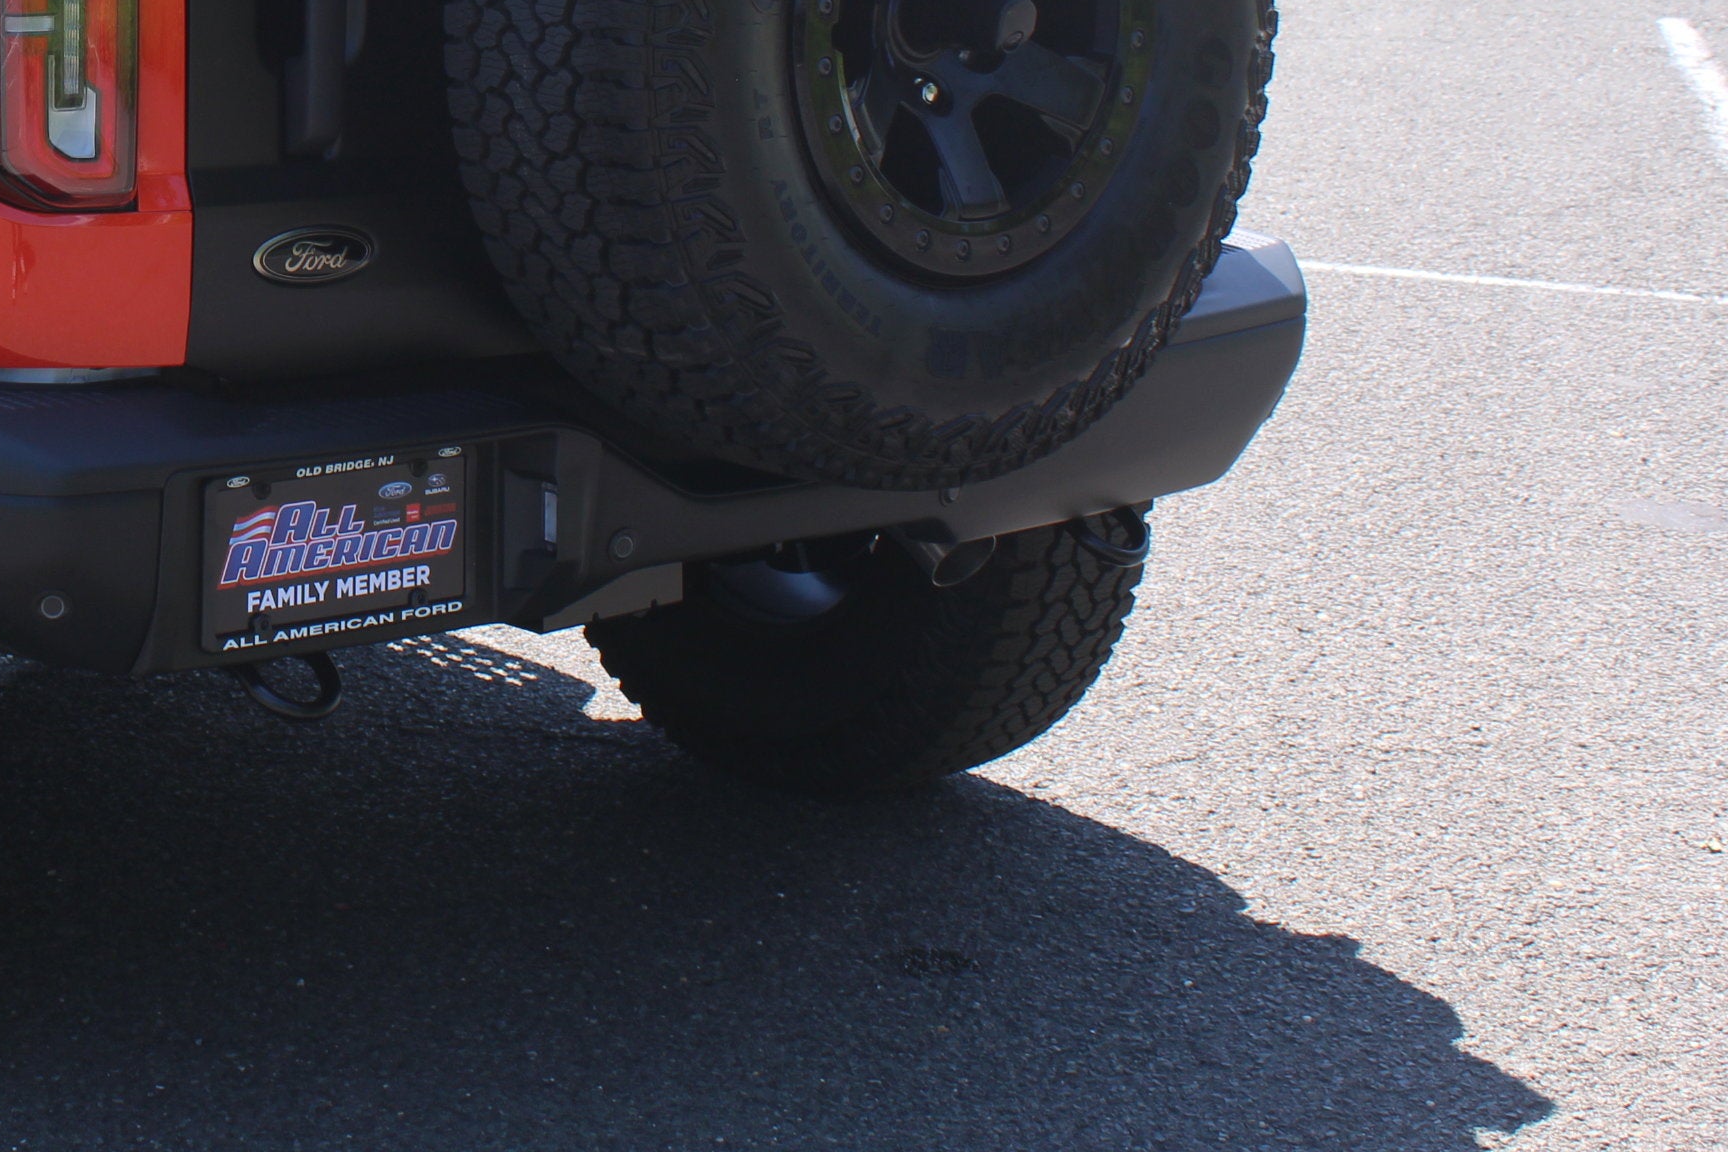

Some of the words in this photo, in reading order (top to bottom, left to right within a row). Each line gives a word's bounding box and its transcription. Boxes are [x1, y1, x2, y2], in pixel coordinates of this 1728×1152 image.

[285, 239, 348, 273] Ford
[297, 465, 322, 478] OLD
[377, 455, 394, 466] NJ
[247, 580, 330, 613] FAMILY
[336, 565, 430, 599] MEMBER
[223, 635, 268, 651] ALL
[273, 612, 394, 643] AMERICAN
[402, 601, 463, 621] FORD
